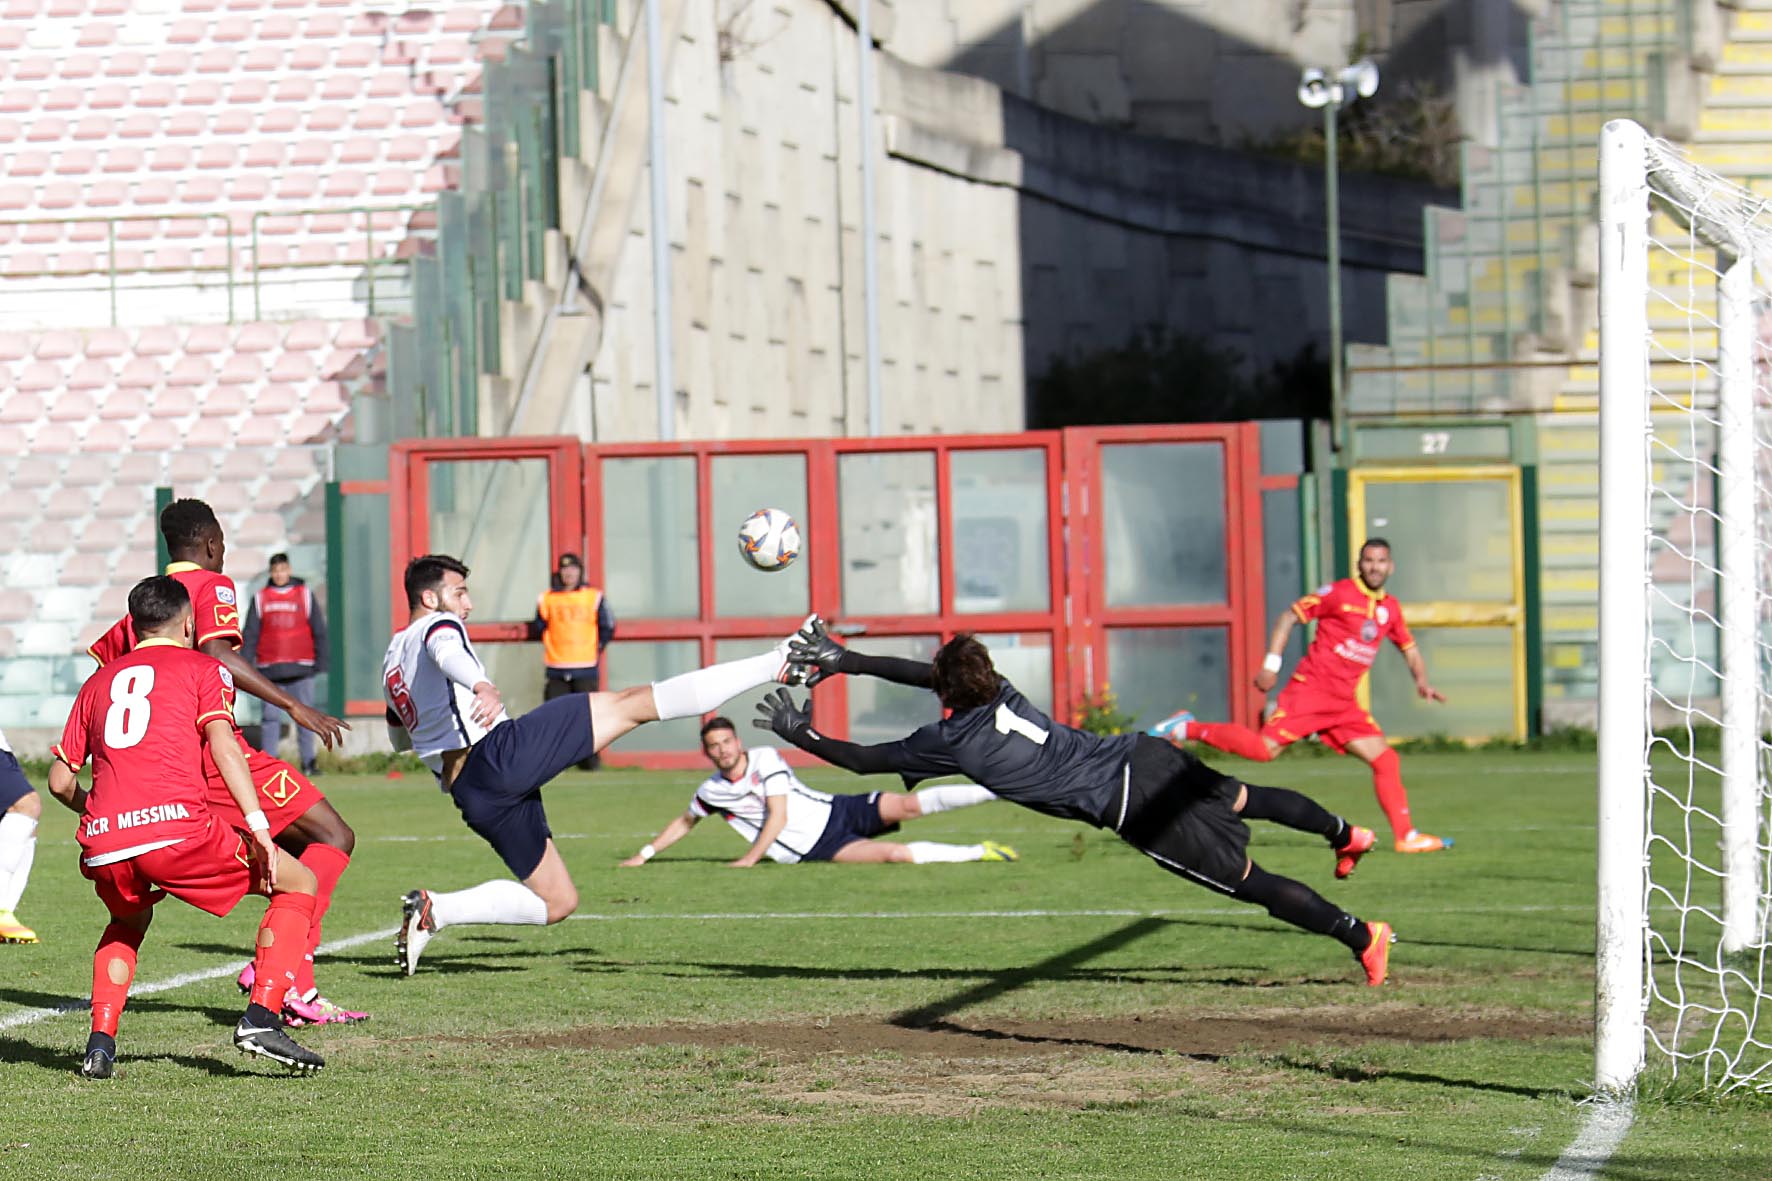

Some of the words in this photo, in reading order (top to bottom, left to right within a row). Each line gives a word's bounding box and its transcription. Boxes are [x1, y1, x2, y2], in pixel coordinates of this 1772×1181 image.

[1422, 432, 1449, 454] 27
[104, 664, 156, 749] 8
[386, 665, 418, 733] 6
[995, 702, 1050, 745] 1
[86, 817, 110, 838] ACR
[117, 804, 190, 830] MESSINA
